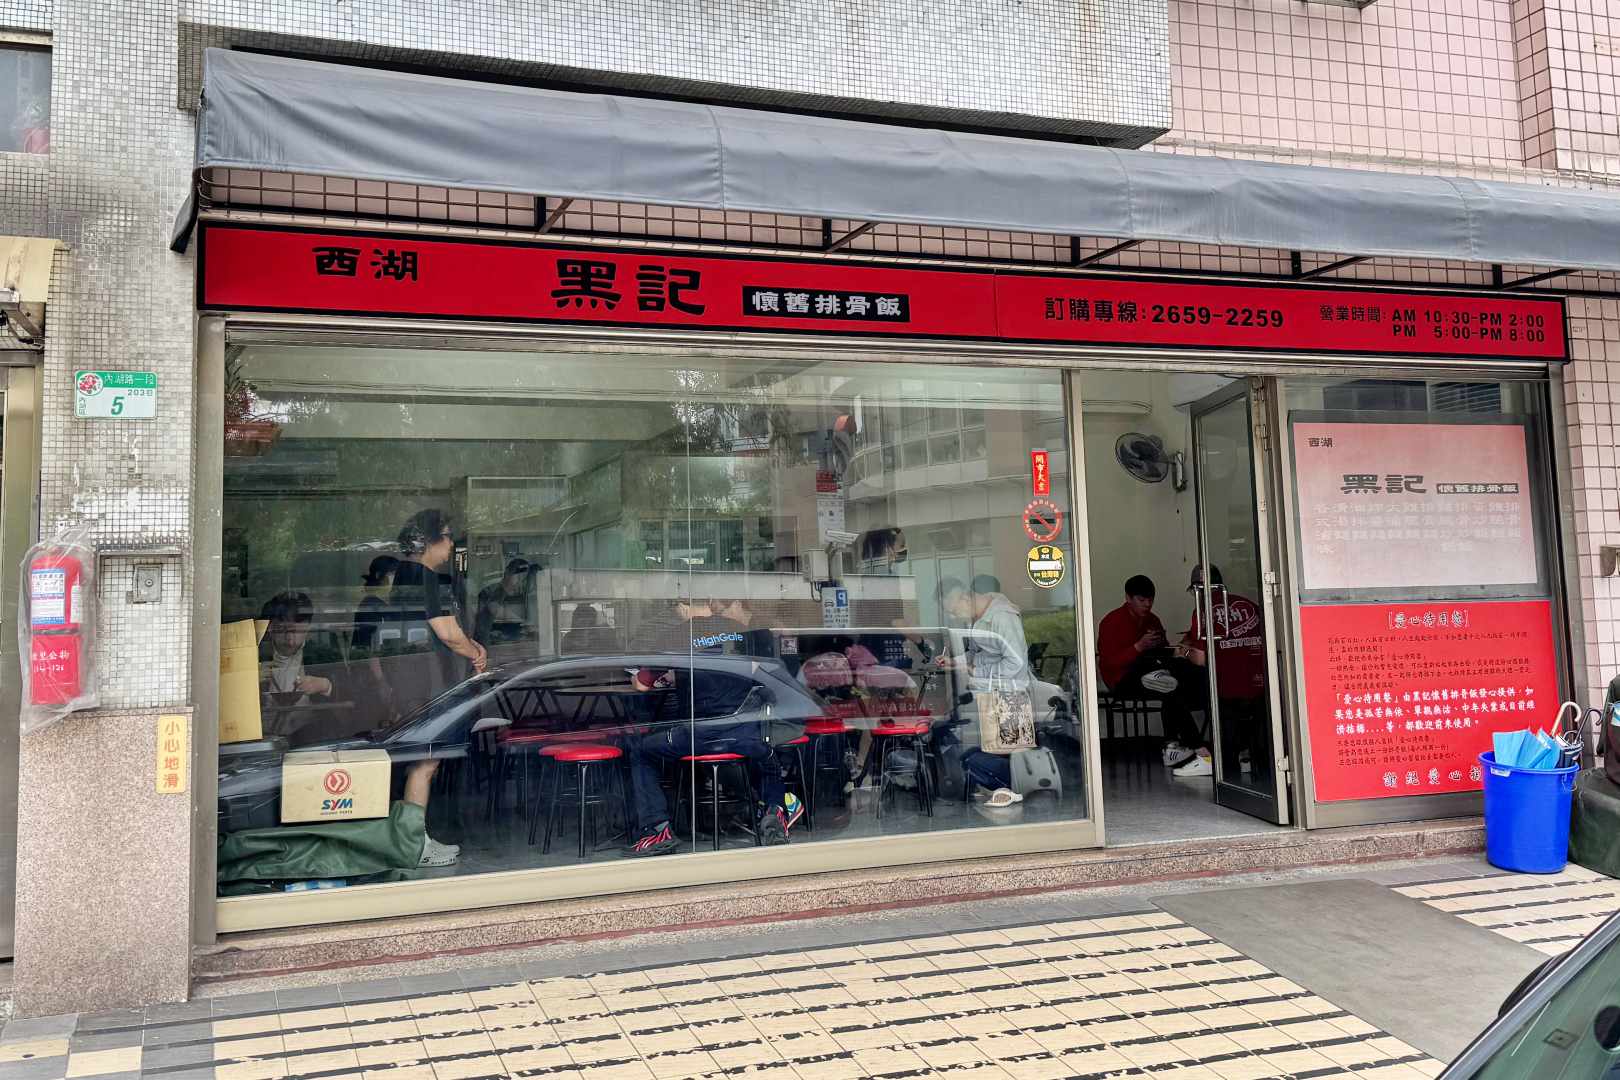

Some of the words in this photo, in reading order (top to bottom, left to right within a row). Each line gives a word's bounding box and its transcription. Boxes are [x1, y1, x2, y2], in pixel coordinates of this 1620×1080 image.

[313, 246, 419, 281] 西湖
[551, 260, 704, 313] 黑記
[752, 291, 901, 316] 懷舊排骨飯
[1392, 309, 1416, 322] AM
[1509, 314, 1544, 327] 2:00
[1392, 324, 1416, 337] PM
[1509, 328, 1544, 342] 8:00
[111, 396, 125, 415] 5
[1308, 437, 1333, 448] 西湖
[1340, 474, 1427, 495] 黑記
[164, 721, 179, 787] 小心地滑
[321, 798, 353, 811] SYM
